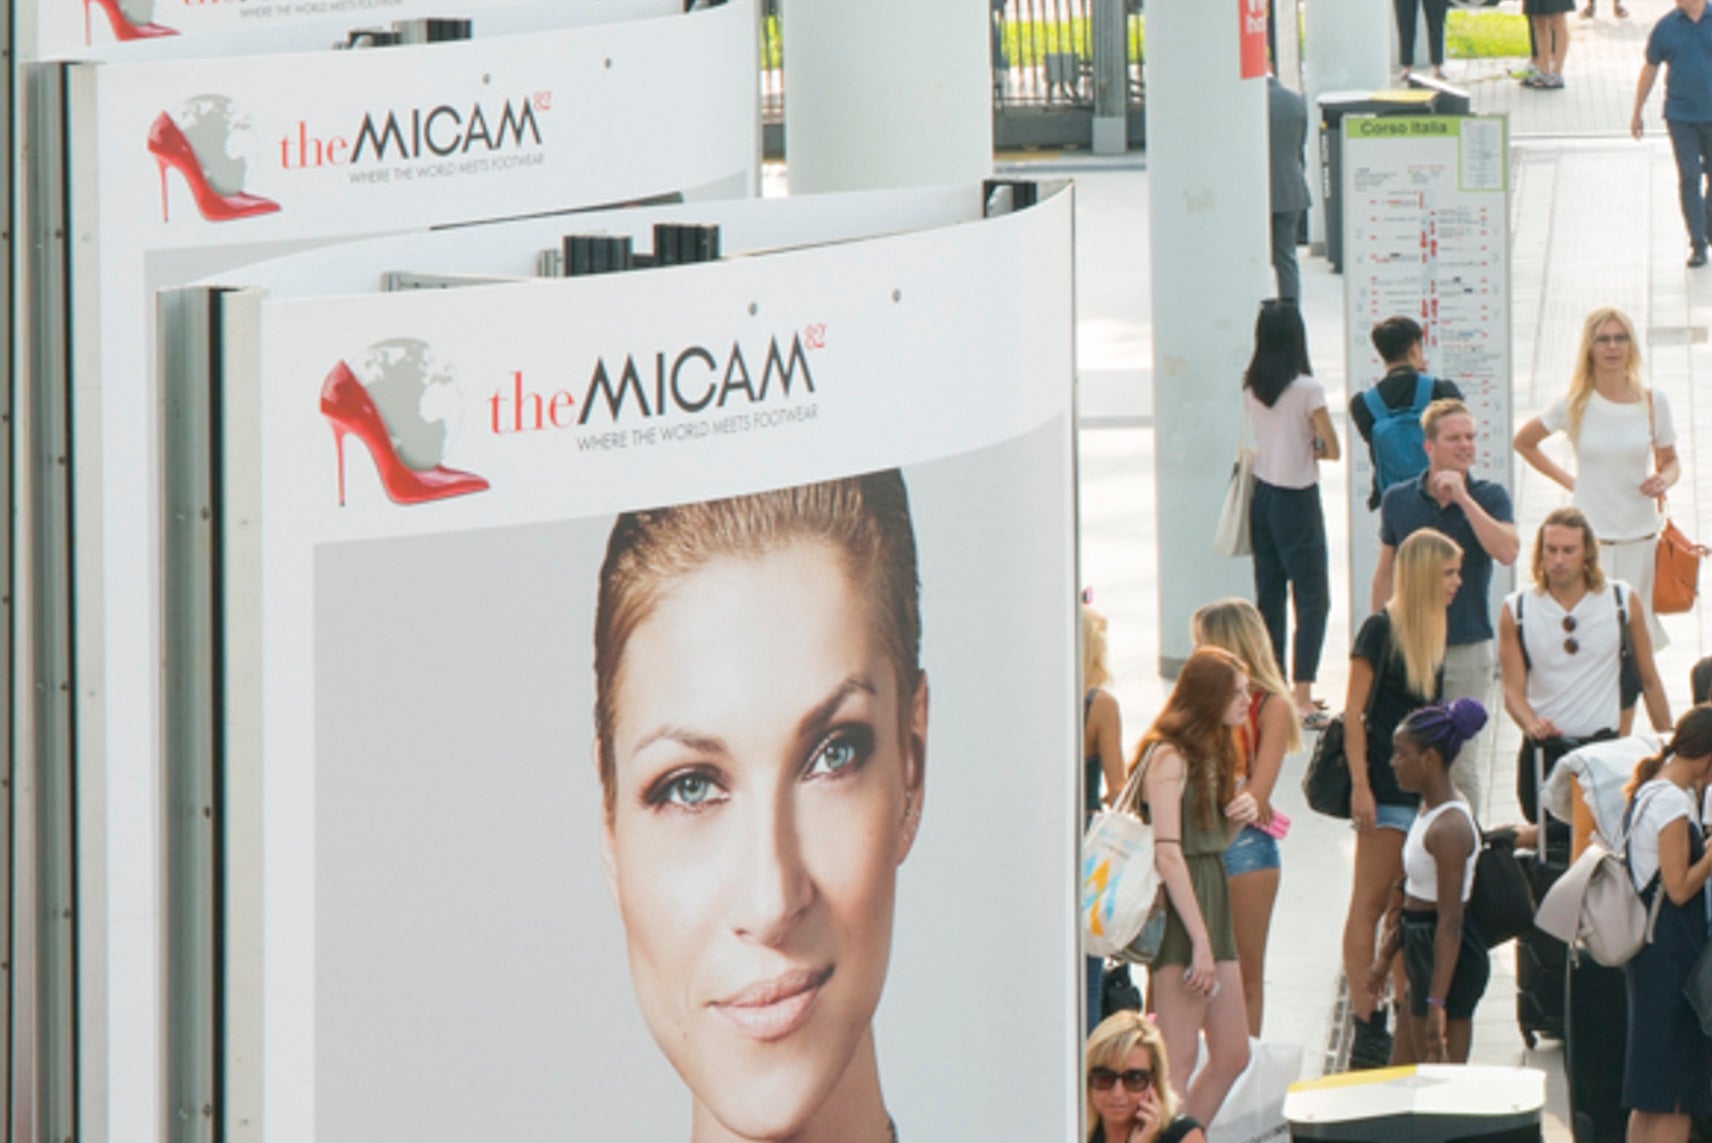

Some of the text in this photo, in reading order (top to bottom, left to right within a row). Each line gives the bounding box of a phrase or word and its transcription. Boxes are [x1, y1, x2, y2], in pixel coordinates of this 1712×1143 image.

[1361, 120, 1447, 136] Corso Italia
[348, 153, 545, 184] WHERE THE WORLD MEETS FOOTWEAR
[576, 404, 819, 452] WHERE THE WORLD MEETS FOOTWEAR
